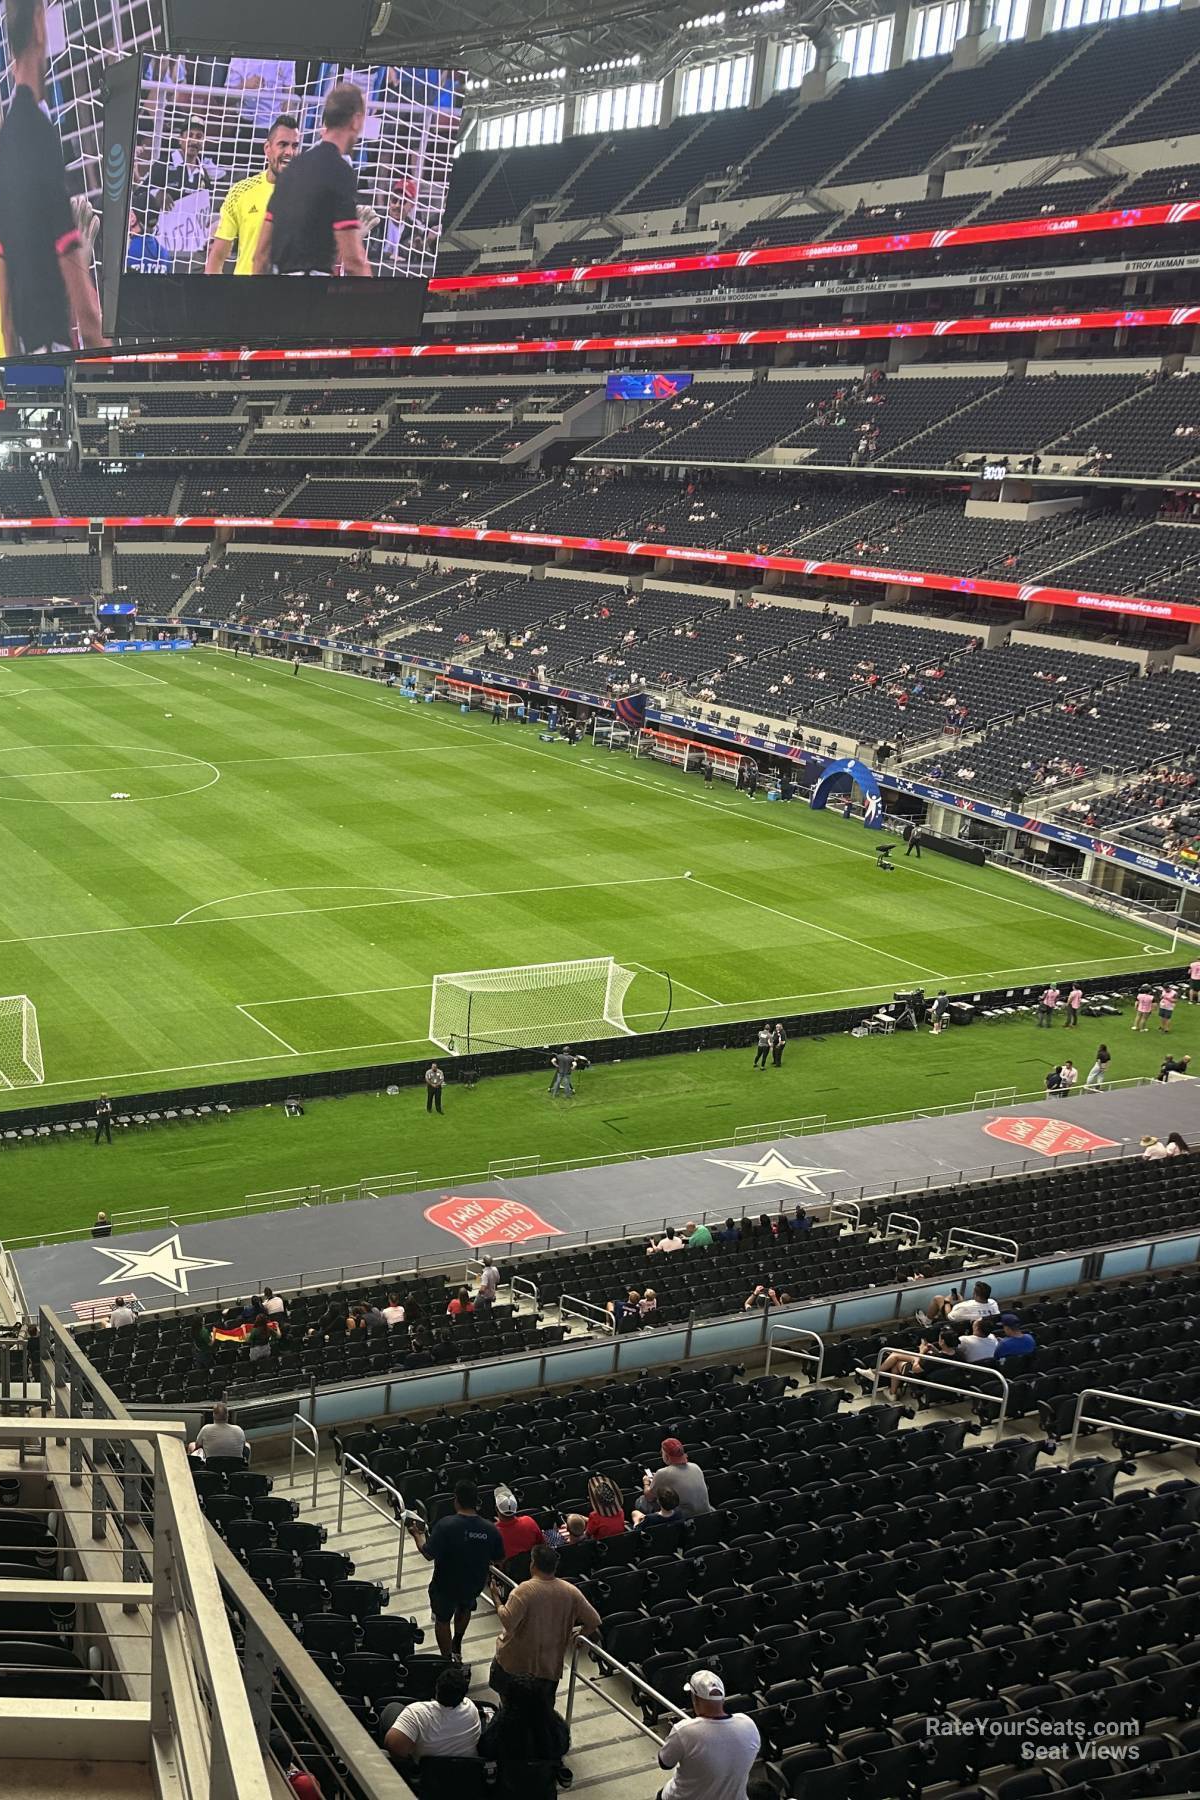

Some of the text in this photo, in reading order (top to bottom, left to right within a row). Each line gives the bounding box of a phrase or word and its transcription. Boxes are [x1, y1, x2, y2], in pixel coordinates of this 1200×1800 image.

[1132, 261, 1152, 270] TROY
[1154, 259, 1185, 268] AIKMAN
[979, 273, 1009, 282] MICHAEL
[1010, 272, 1030, 280] IRVIN
[865, 283, 887, 291] HALEY
[990, 316, 1081, 330] store.copaamerica.com
[983, 467, 1006, 480] 30:00
[1077, 595, 1172, 616] store.copaamerica.com
[447, 1200, 485, 1228] ARMY
[460, 1202, 525, 1242] SALVATION
[500, 1220, 534, 1239] THE
